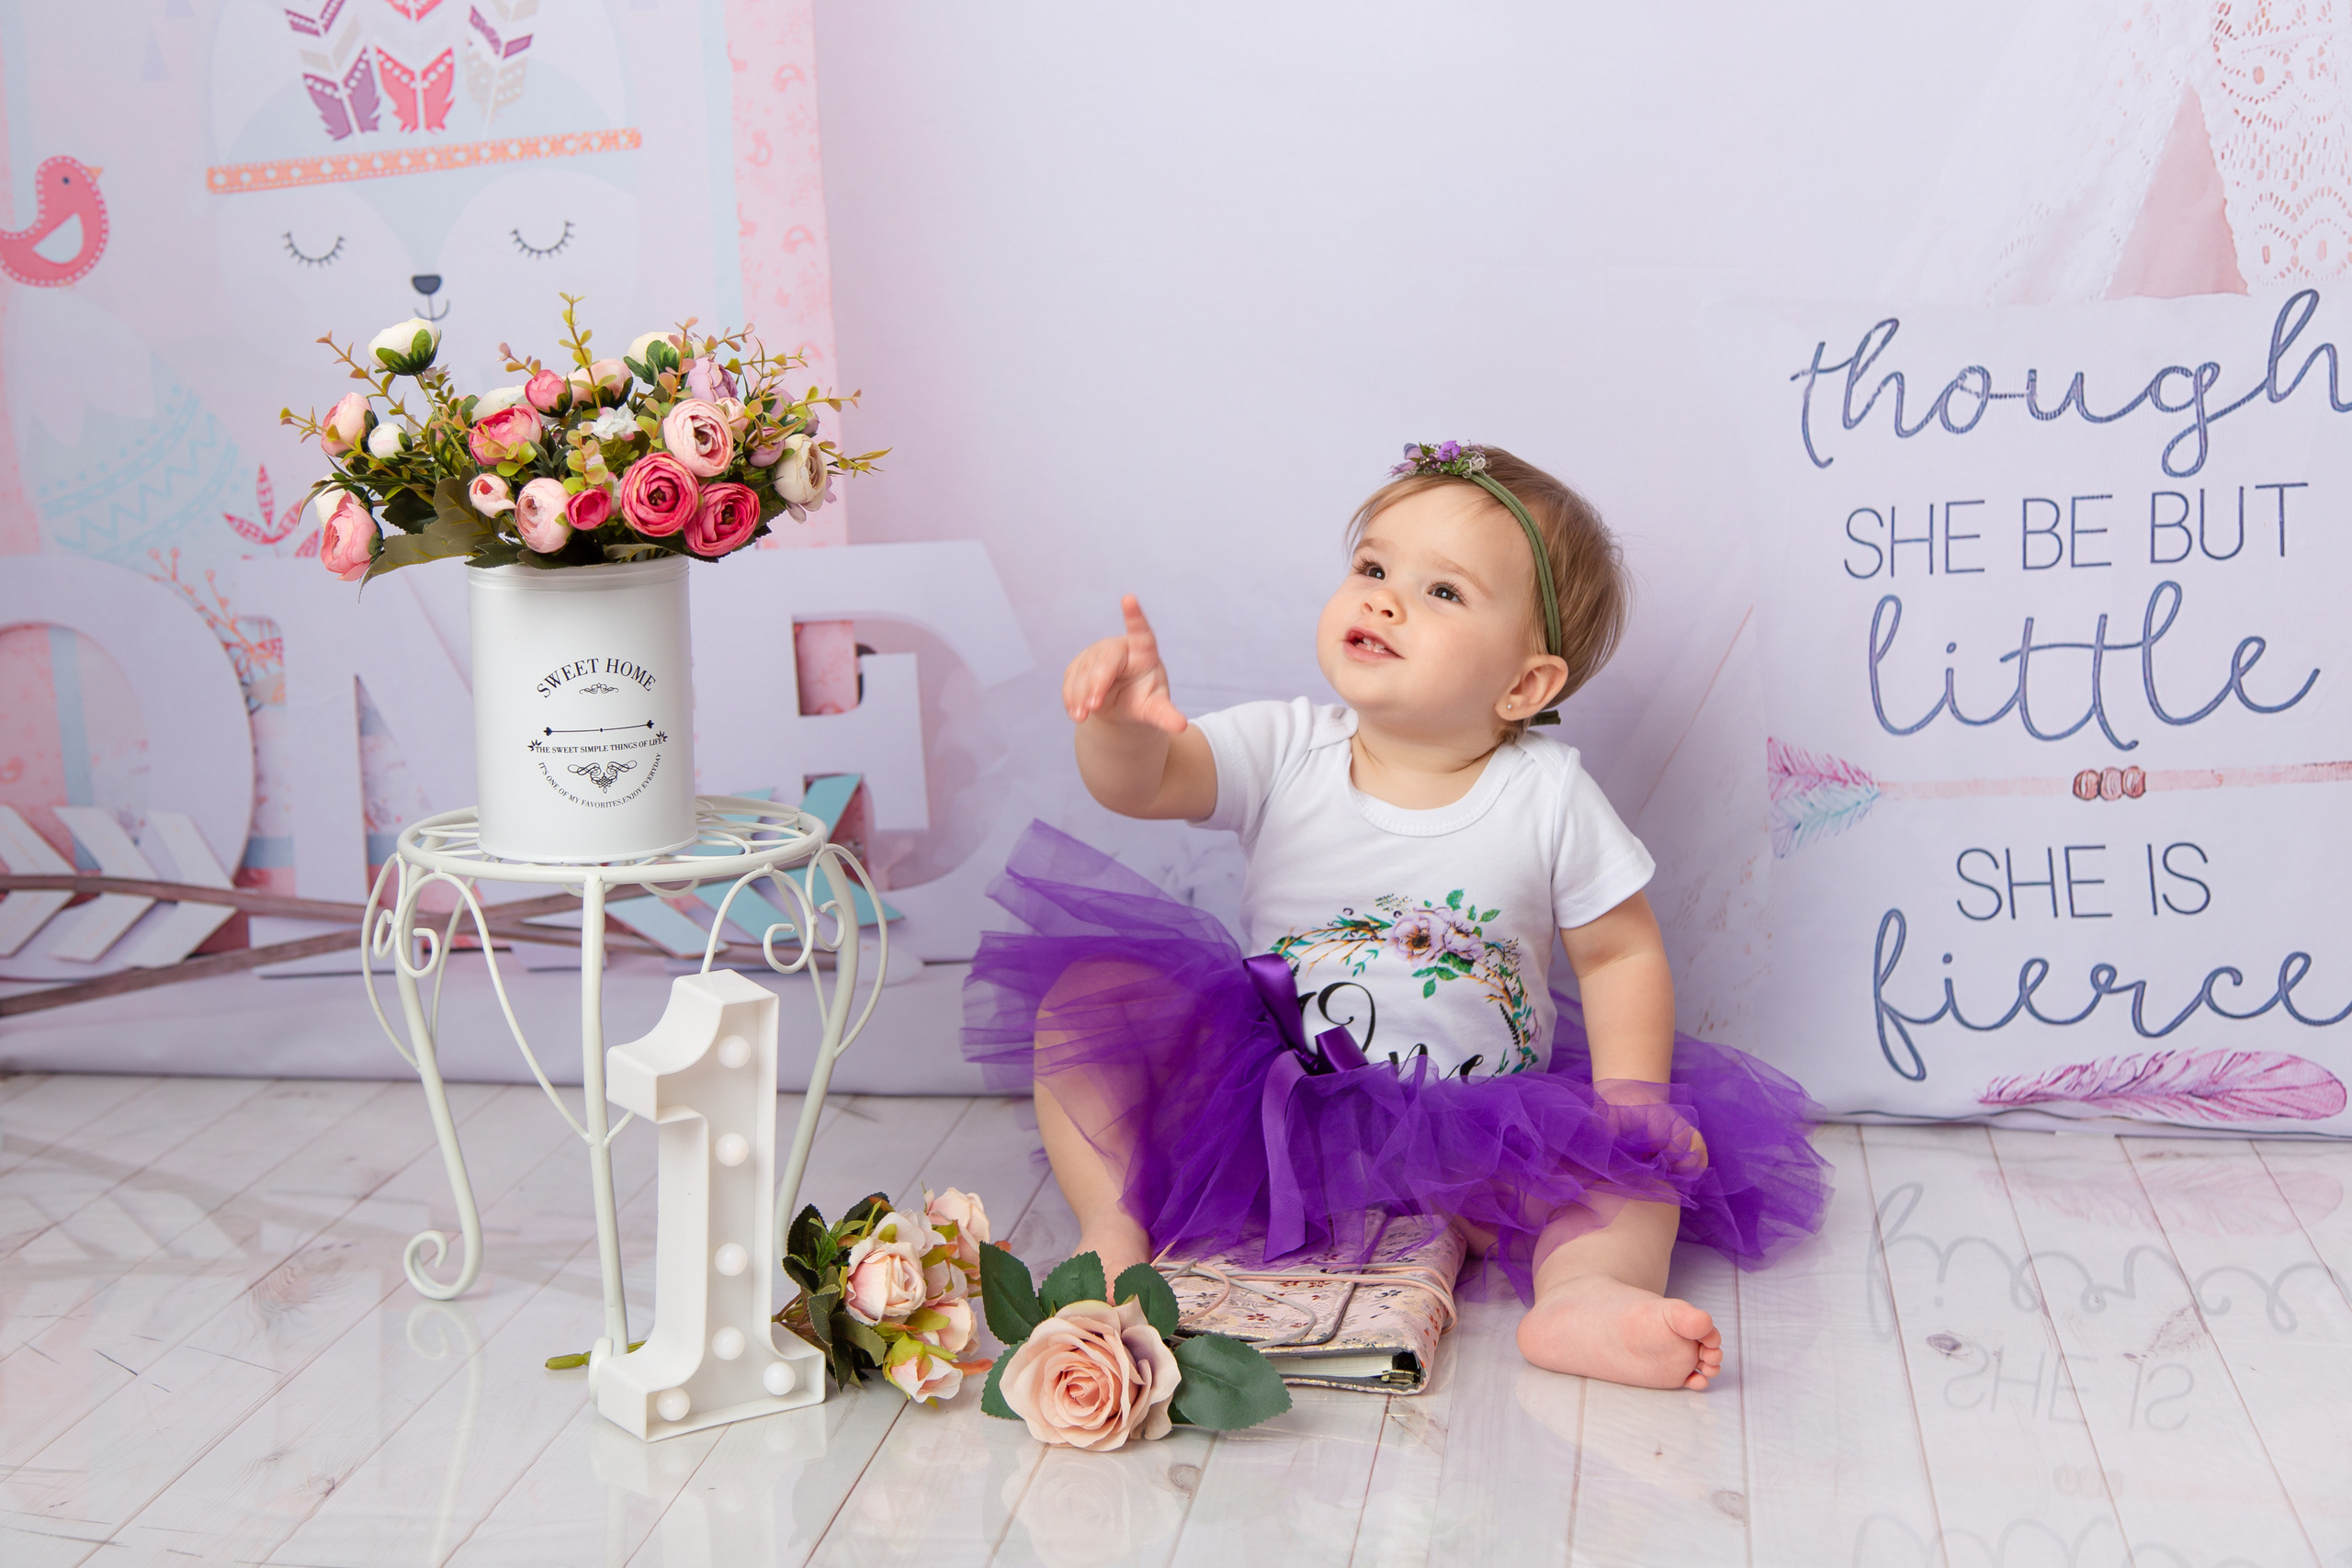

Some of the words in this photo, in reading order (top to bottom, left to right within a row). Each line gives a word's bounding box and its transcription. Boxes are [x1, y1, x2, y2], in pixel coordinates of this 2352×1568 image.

[1791, 288, 2352, 478] though
[1844, 501, 1985, 580] SHE
[2022, 493, 2113, 570] BE
[2150, 482, 2309, 565] BUT
[537, 658, 599, 698] SWEET
[605, 658, 656, 692] HOME
[1869, 581, 2321, 751] little
[546, 775, 560, 790] ONE
[558, 788, 569, 797] OF
[568, 795, 580, 804] MY
[641, 752, 662, 789] EVERYDAY
[610, 742, 638, 751] THINGS
[639, 739, 648, 748] OF
[649, 738, 663, 746] LIFE
[1956, 845, 2112, 921] SHE
[2147, 841, 2211, 917] IS
[1873, 908, 2352, 1082] fierce
